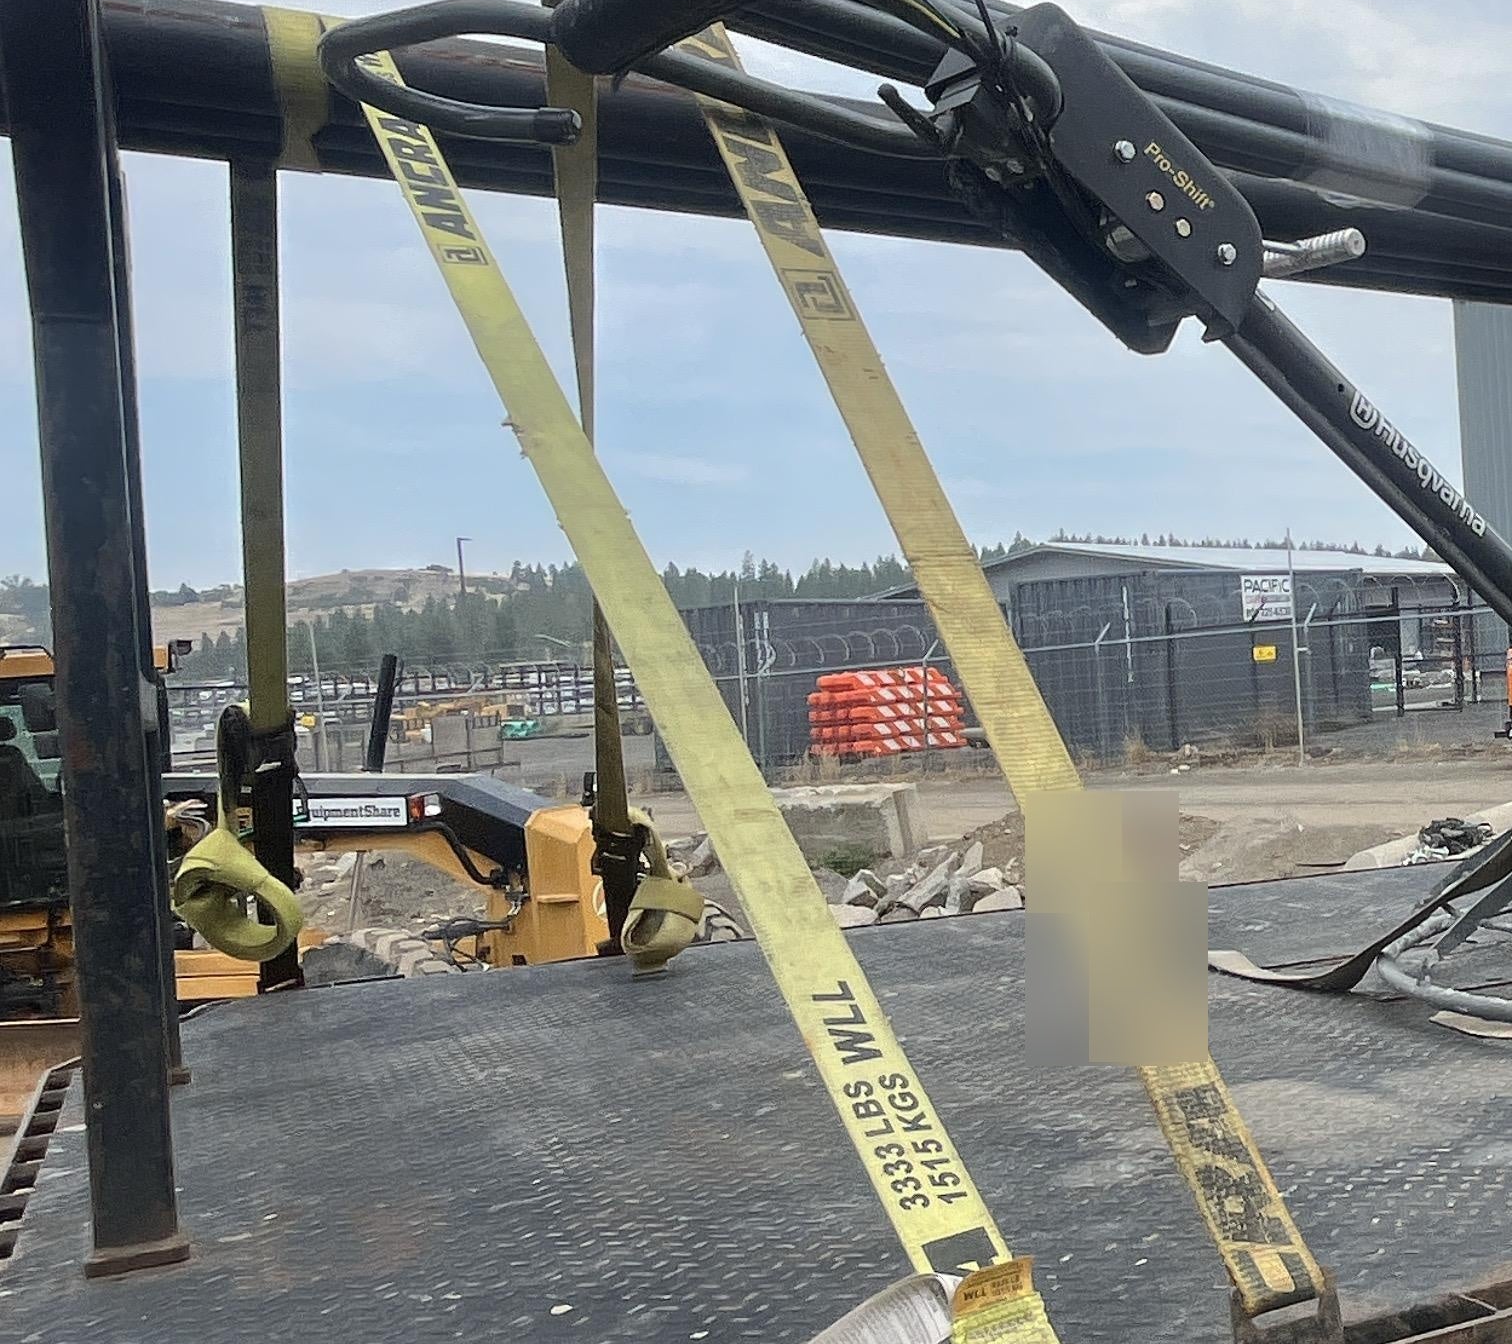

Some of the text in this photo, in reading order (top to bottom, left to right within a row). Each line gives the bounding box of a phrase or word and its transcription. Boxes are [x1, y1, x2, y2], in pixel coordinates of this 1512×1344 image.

[378, 116, 477, 241] ANCRA
[1374, 418, 1488, 537] Husqvarna
[1244, 579, 1290, 593] PACIFIC
[298, 805, 400, 821] uipmentShare
[812, 980, 883, 1065] WLL
[843, 1080, 930, 1210] 3333 LBS
[878, 1072, 968, 1204] 1515 KGS
